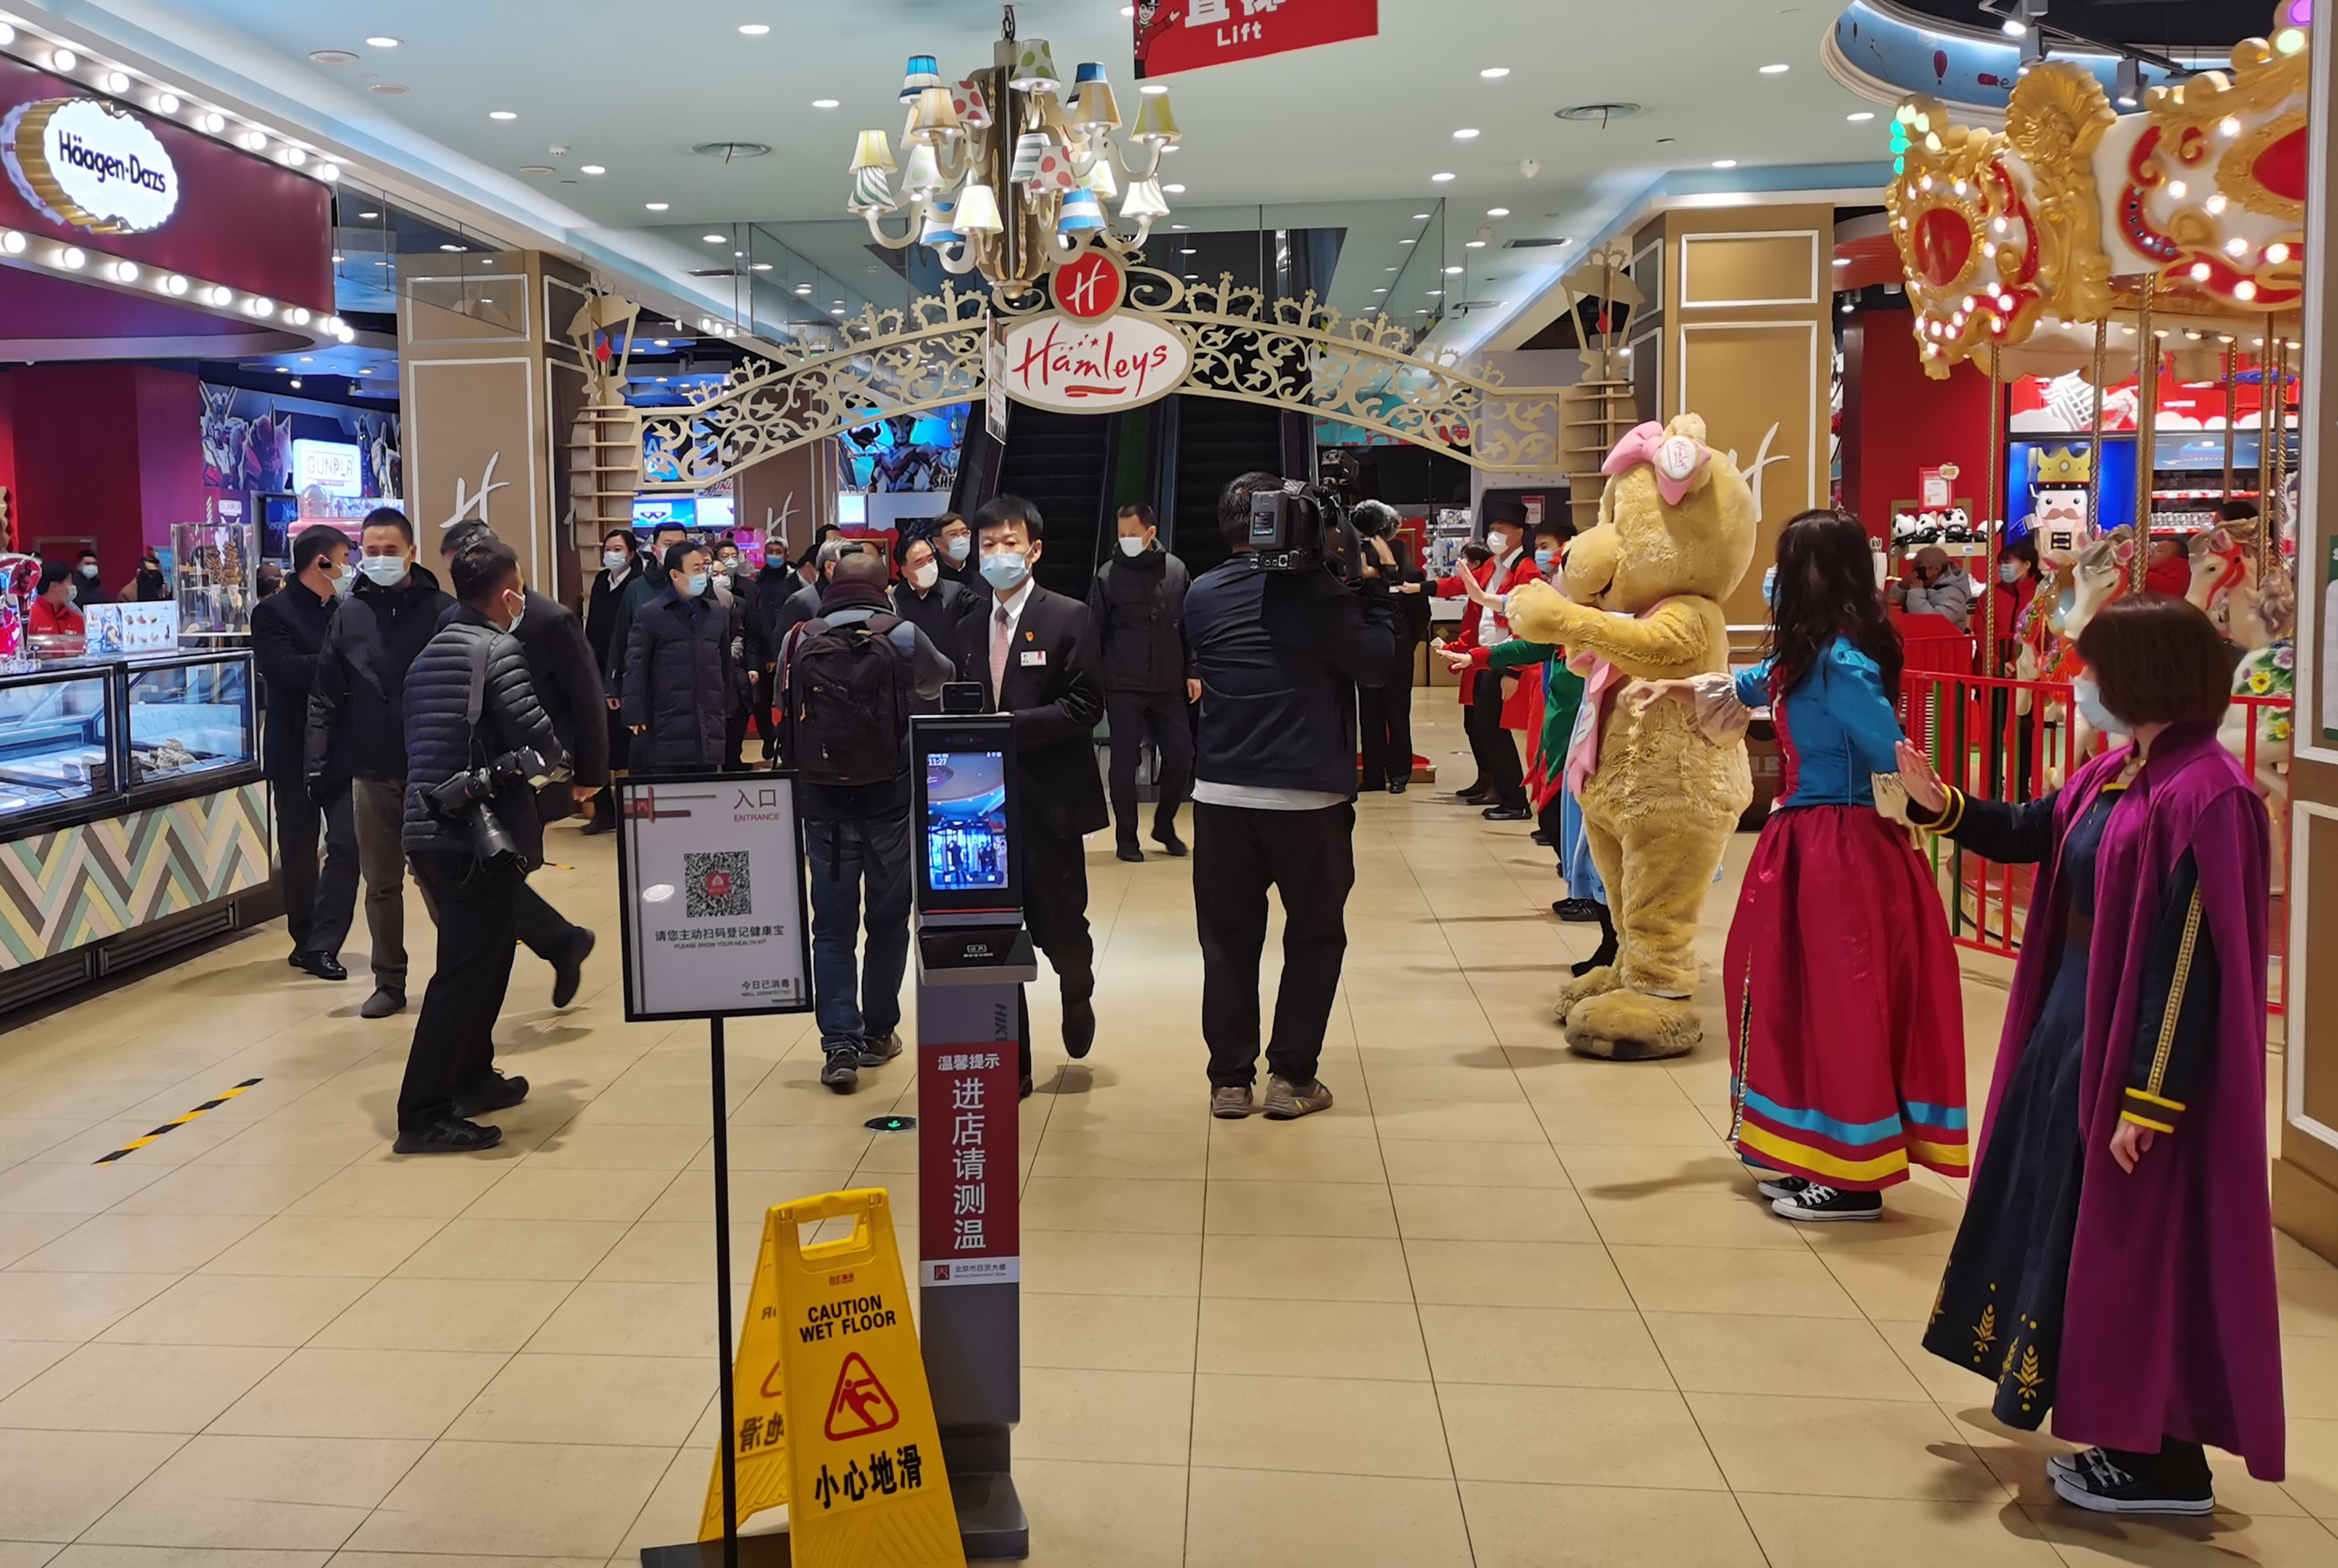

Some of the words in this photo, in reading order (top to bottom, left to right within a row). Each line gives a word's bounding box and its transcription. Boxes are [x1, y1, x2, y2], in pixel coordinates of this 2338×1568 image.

[1217, 21, 1262, 47] Lift
[1066, 258, 1108, 314] H
[1011, 320, 1167, 398] Hamleys
[307, 455, 353, 478] GUNPLA
[734, 788, 777, 810] 入口
[735, 812, 780, 822] ENTRANCE
[655, 925, 785, 942] 请您主动扫码登记健康宝
[741, 979, 790, 990] 今日已消毒
[938, 1053, 1000, 1071] 温馨提示
[952, 1077, 987, 1250] 进店请测温
[807, 1294, 882, 1323] CAUTION
[799, 1321, 834, 1344] WET
[842, 1310, 896, 1335] FLOOR
[815, 1443, 922, 1509] 小心地滑
